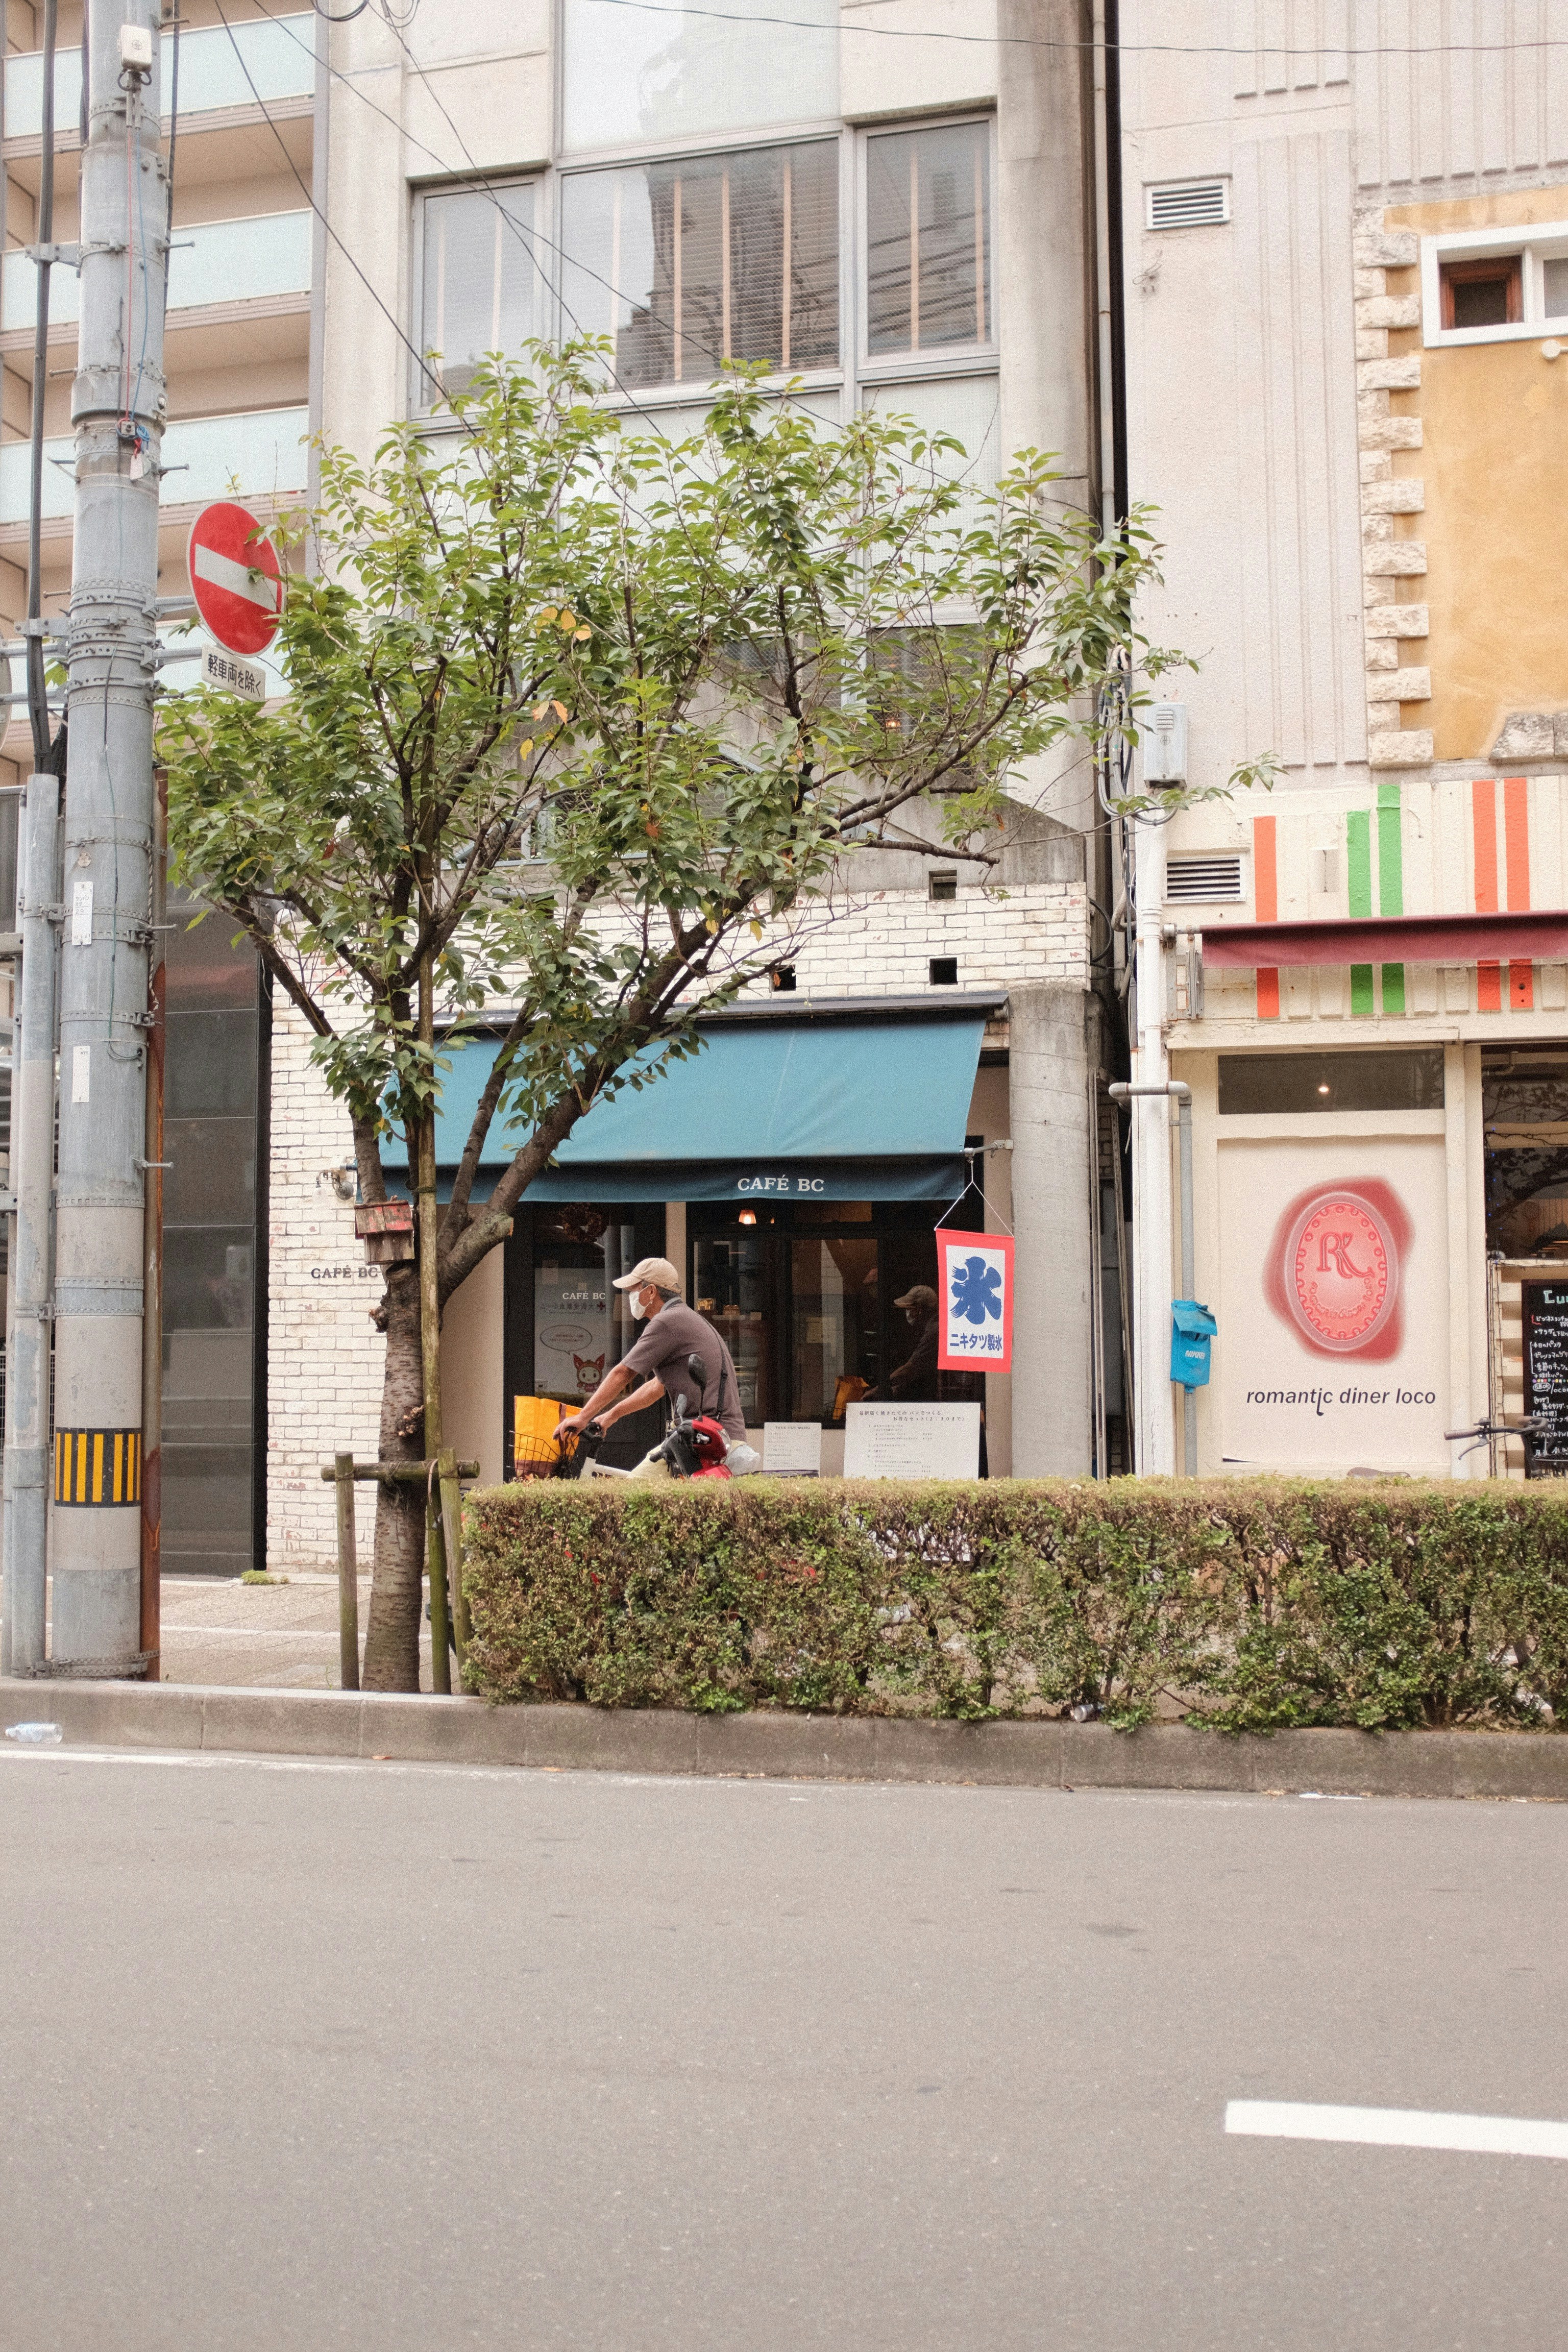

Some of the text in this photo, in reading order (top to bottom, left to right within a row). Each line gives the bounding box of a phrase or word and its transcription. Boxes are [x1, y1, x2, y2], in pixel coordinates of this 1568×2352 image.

[208, 653, 261, 697] 軽車両を除く
[737, 1174, 824, 1192] CAFÉ BC
[311, 1265, 378, 1279] CAFÉ BC
[562, 1291, 589, 1300] CAFÉ
[949, 1256, 1002, 1325] 氷
[949, 1332, 1002, 1351] ニキタツ製氷
[1185, 1350, 1205, 1359] NIKKEI
[1246, 1387, 1436, 1416] romantic diner loco
